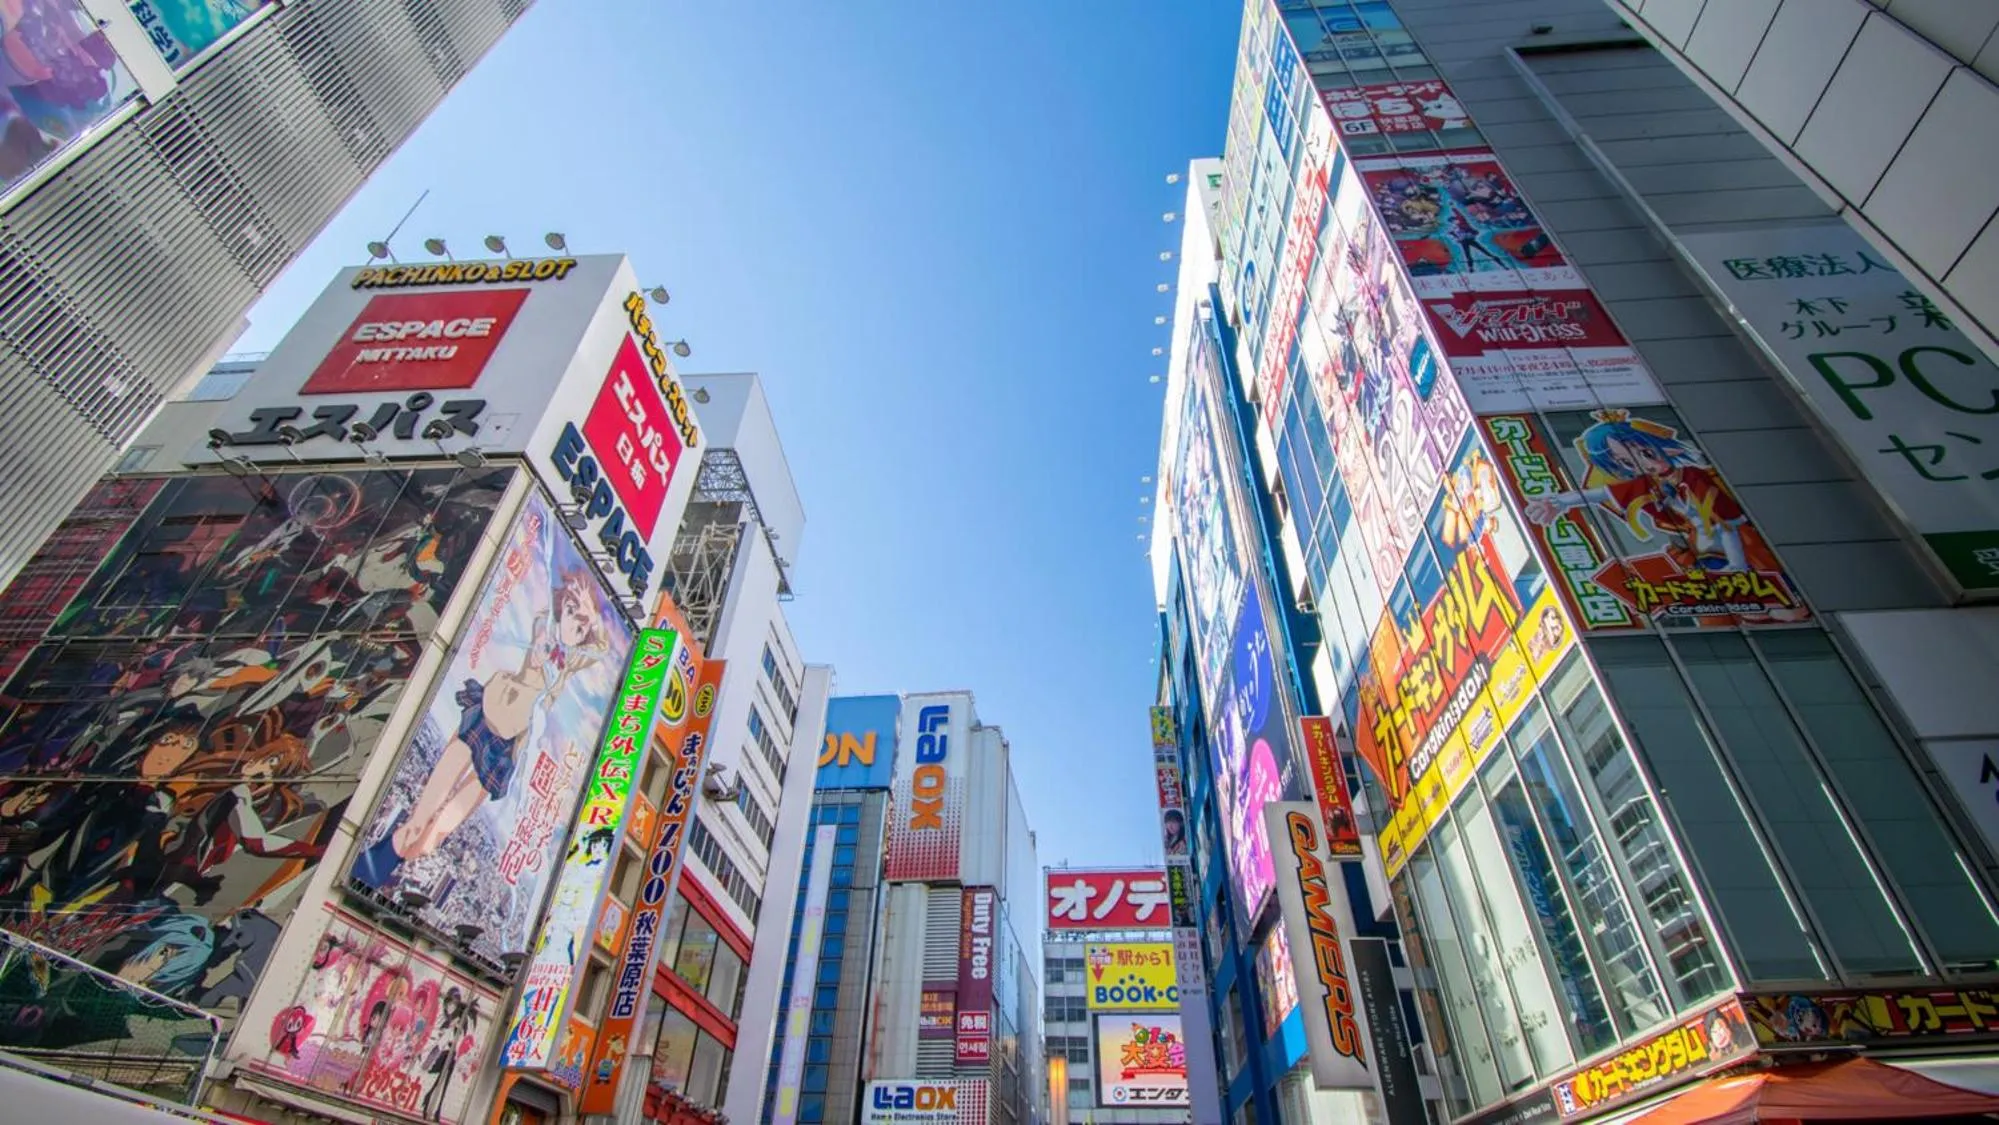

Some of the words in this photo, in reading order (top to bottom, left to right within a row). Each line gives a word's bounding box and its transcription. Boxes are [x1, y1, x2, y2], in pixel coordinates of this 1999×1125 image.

[1345, 121, 1374, 133] 6F
[1723, 251, 1898, 280] 医療法人
[352, 317, 496, 343] ESPACE
[357, 346, 458, 363] NITTAKU
[230, 392, 485, 443] エスパス
[613, 370, 671, 486] エスパス
[550, 421, 655, 599] ESPACE
[1488, 418, 1627, 625] カードゲム専門店
[1626, 566, 1800, 612] カードキングダム
[1374, 552, 1521, 801] カードキングダム
[972, 892, 992, 934] Duty
[610, 911, 657, 1018] 秋葉原店
[971, 936, 991, 980] Free
[1286, 810, 1370, 1074] GAMERS
[1897, 991, 1999, 1030] カード
[1589, 1024, 1707, 1097] カードキングダム
[1129, 1088, 1190, 1101] エンタ
